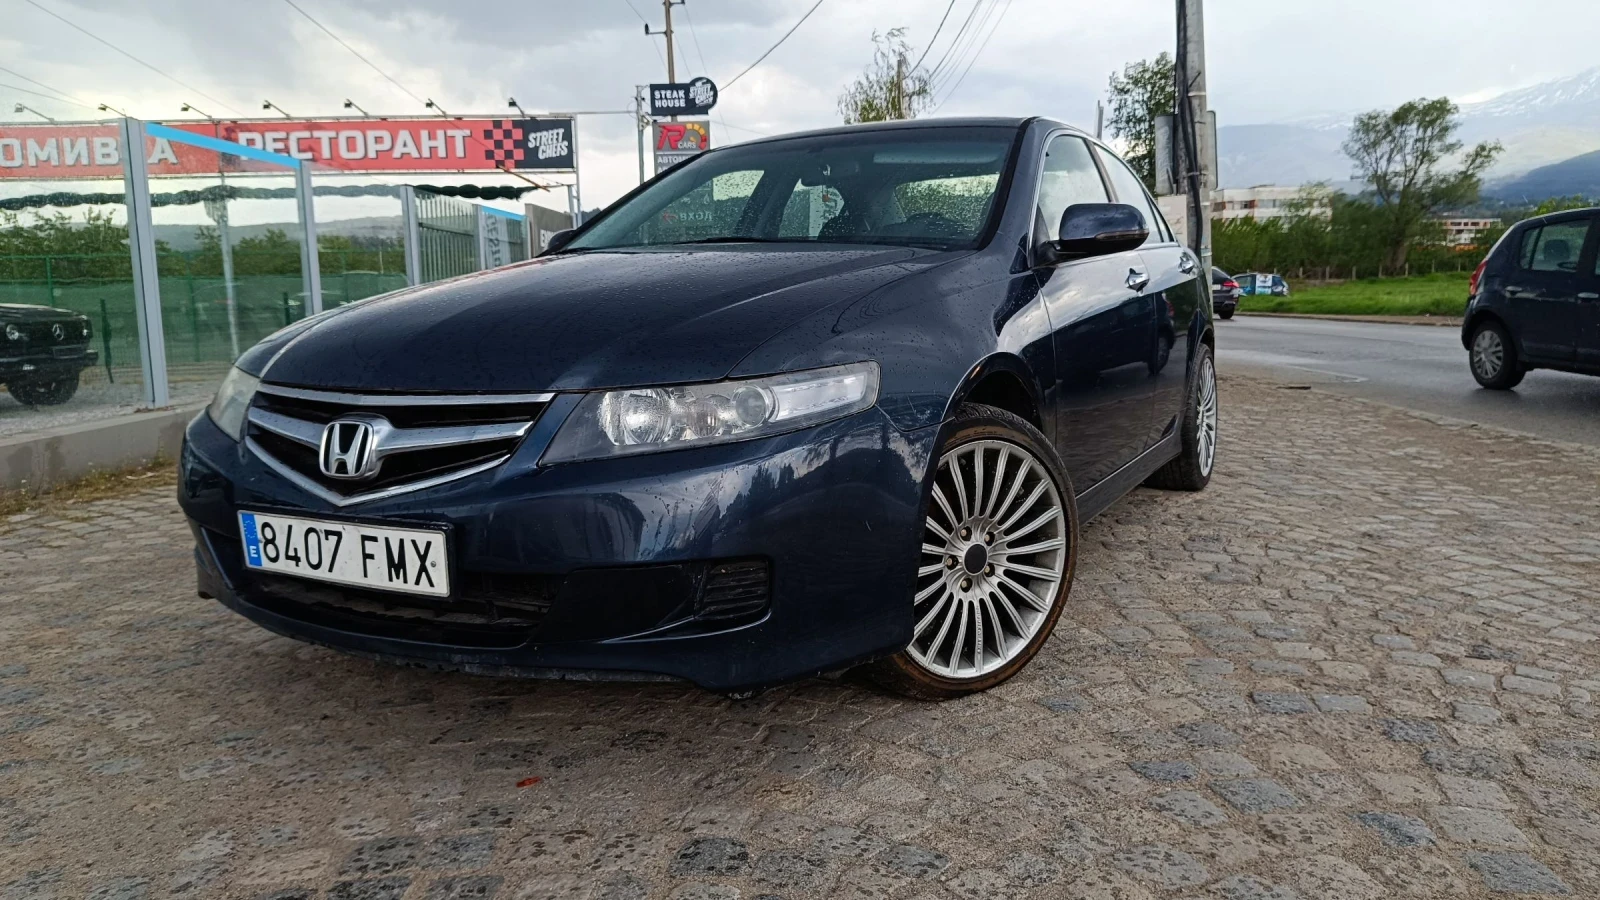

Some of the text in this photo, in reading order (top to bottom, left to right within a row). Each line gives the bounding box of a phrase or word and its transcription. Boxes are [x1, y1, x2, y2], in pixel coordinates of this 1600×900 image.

[654, 90, 685, 99] STEAK
[655, 99, 686, 108] HOUSE
[528, 128, 564, 148] STREET
[0, 129, 471, 167] ОМИВА РЕСТОРАНТ
[538, 140, 568, 159] CHEFS
[250, 545, 258, 557] E
[260, 521, 435, 588] 8407 FMX
